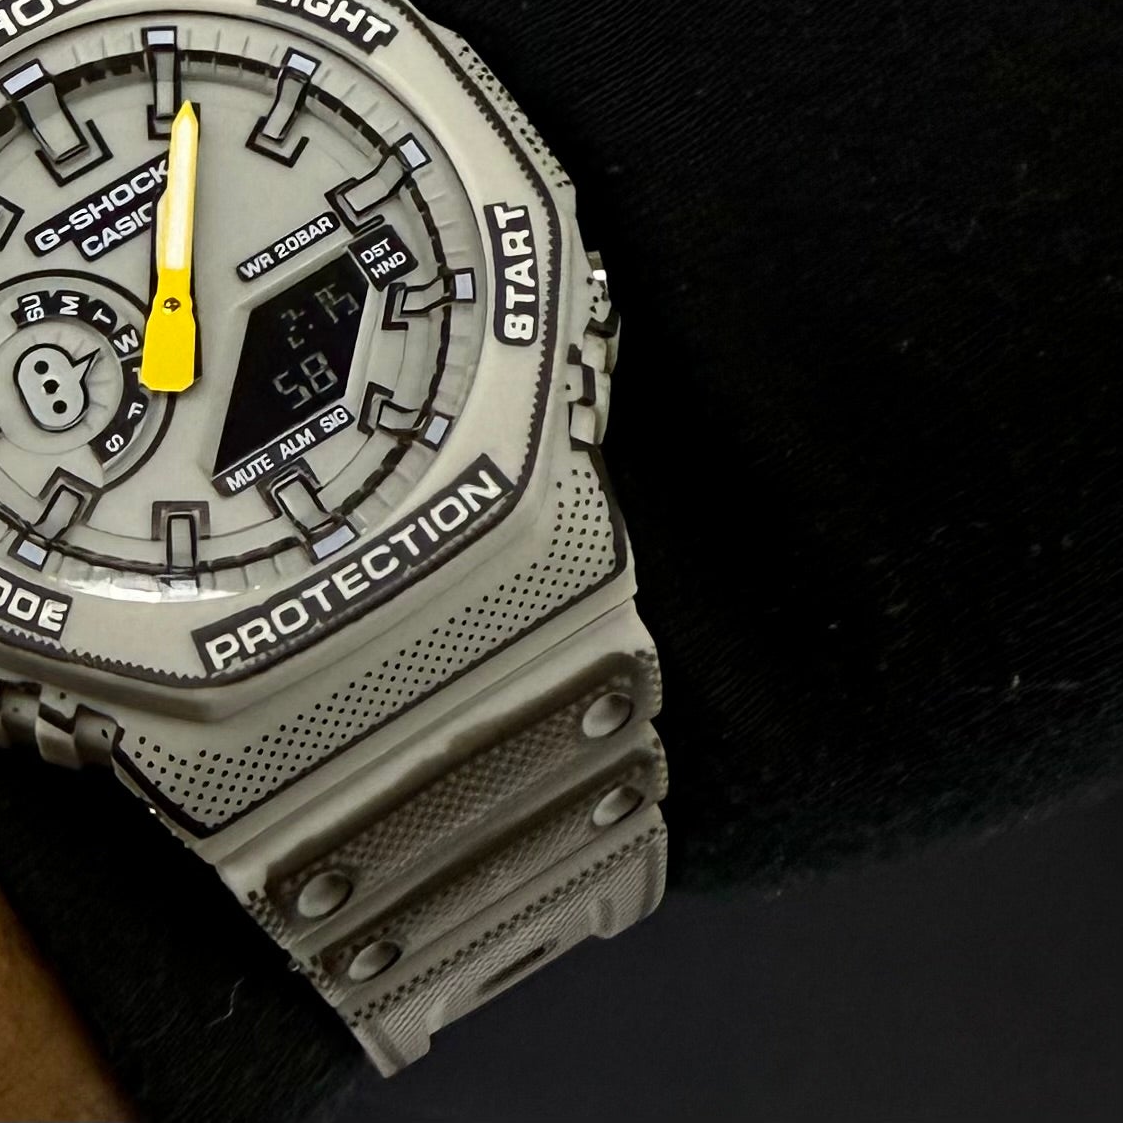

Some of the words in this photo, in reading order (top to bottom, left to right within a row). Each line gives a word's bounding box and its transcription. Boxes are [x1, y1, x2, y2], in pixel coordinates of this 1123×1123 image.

[34, 159, 169, 251] G-SHOCK
[239, 252, 275, 278] WR
[274, 216, 334, 259] 20BAR
[360, 238, 392, 264] DST
[370, 251, 407, 279] HND
[21, 294, 45, 322] SU
[59, 295, 81, 316] M
[92, 308, 112, 324] T
[113, 329, 139, 353] W
[272, 351, 339, 410] 58
[127, 402, 144, 420] F
[105, 433, 124, 453] S
[226, 453, 275, 491] MUTE
[279, 427, 316, 460] ALM
[319, 407, 349, 434] SIG
[205, 468, 502, 670] PROTECTION
